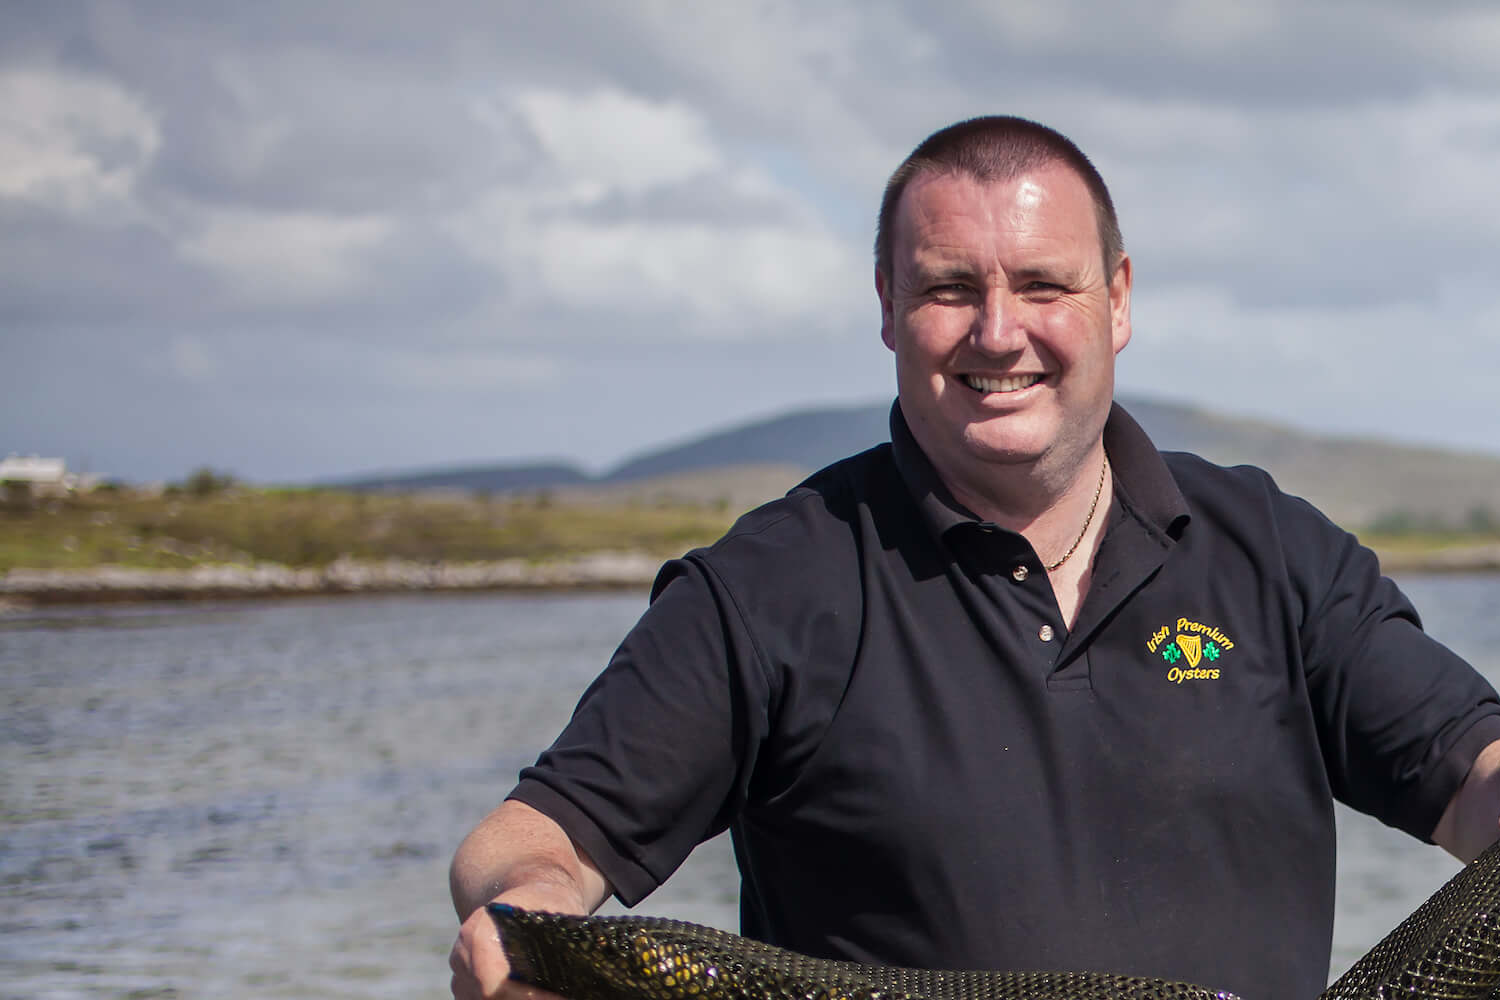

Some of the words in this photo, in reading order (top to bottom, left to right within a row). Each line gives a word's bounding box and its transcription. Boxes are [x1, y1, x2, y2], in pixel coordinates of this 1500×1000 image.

[1146, 626, 1170, 653] Irish
[1176, 617, 1234, 650] Premium
[1167, 667, 1220, 684] Oysters
